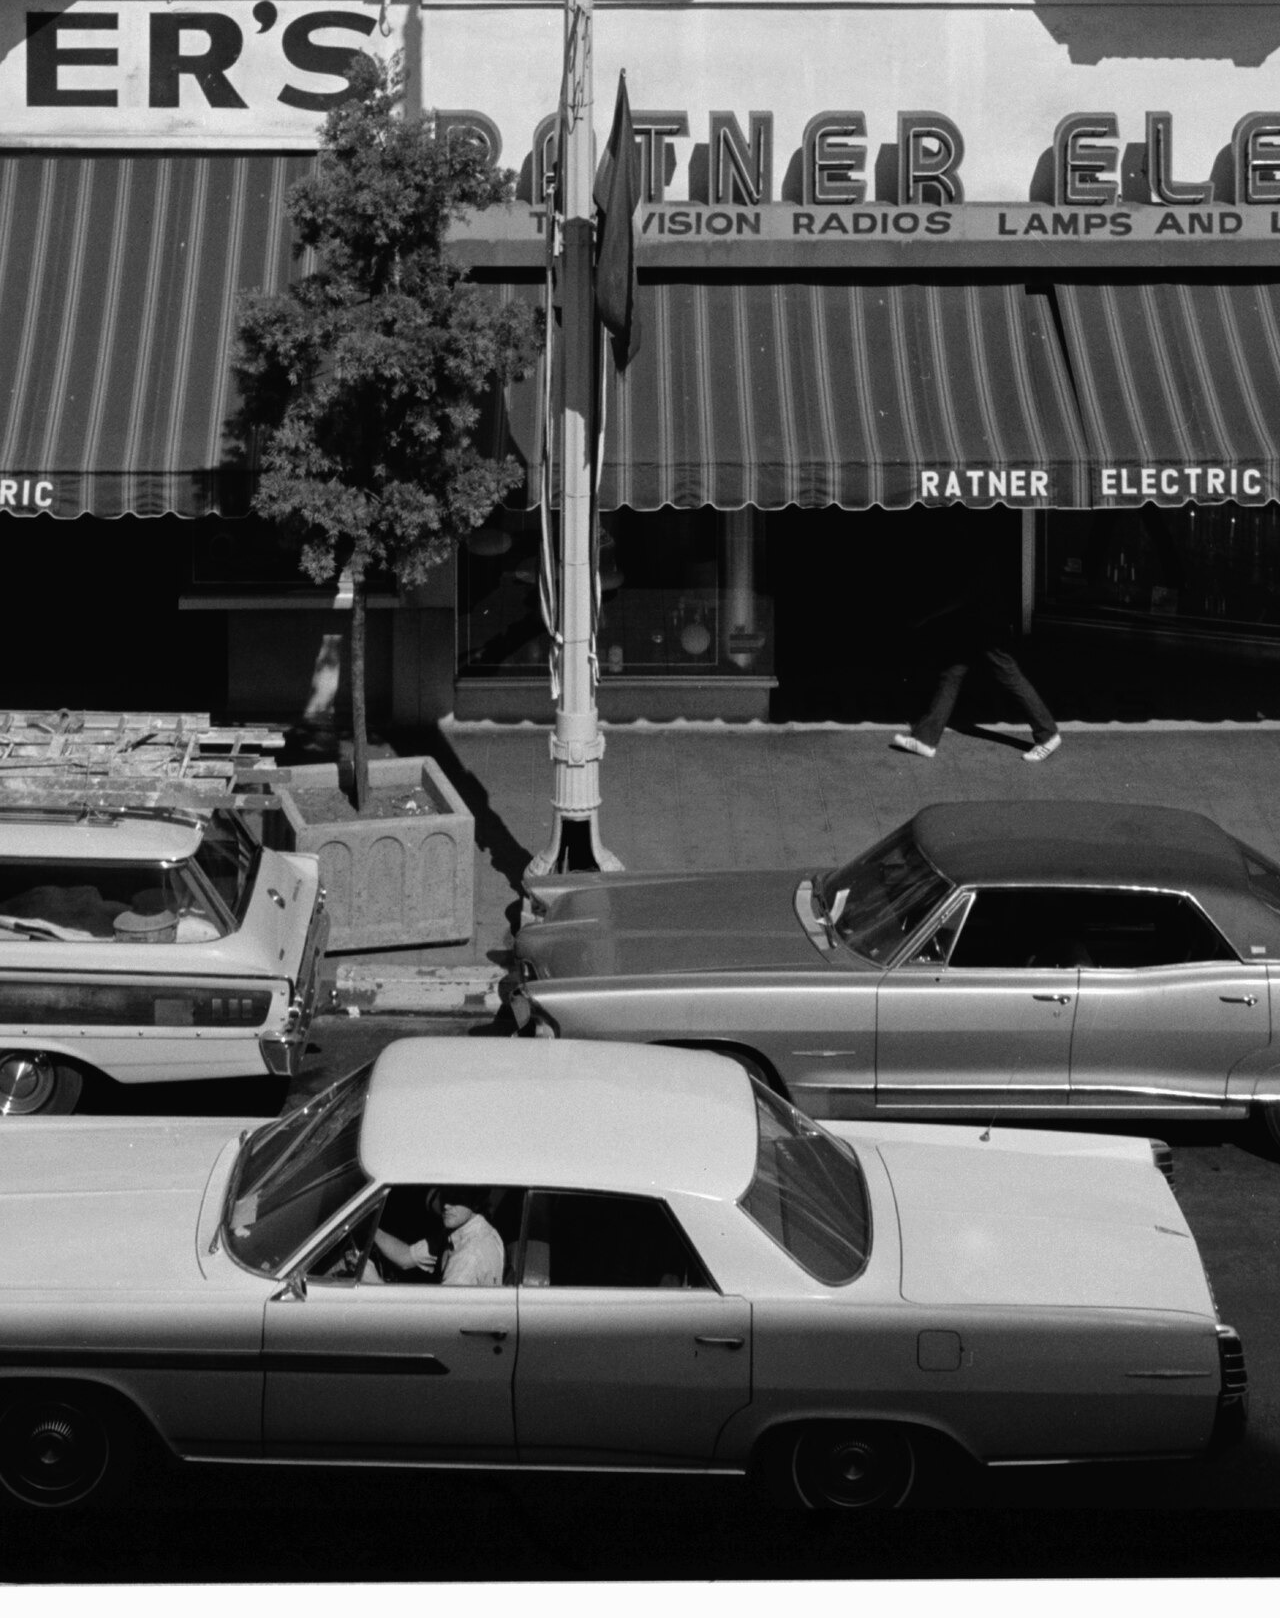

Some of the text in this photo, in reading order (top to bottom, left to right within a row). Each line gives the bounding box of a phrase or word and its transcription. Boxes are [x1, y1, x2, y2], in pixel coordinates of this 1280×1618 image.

[792, 211, 953, 236] RADIOS
[998, 211, 1133, 237] LAMPS
[1155, 211, 1243, 236] AND
[921, 468, 1262, 497] RATNER ELECTRIC
